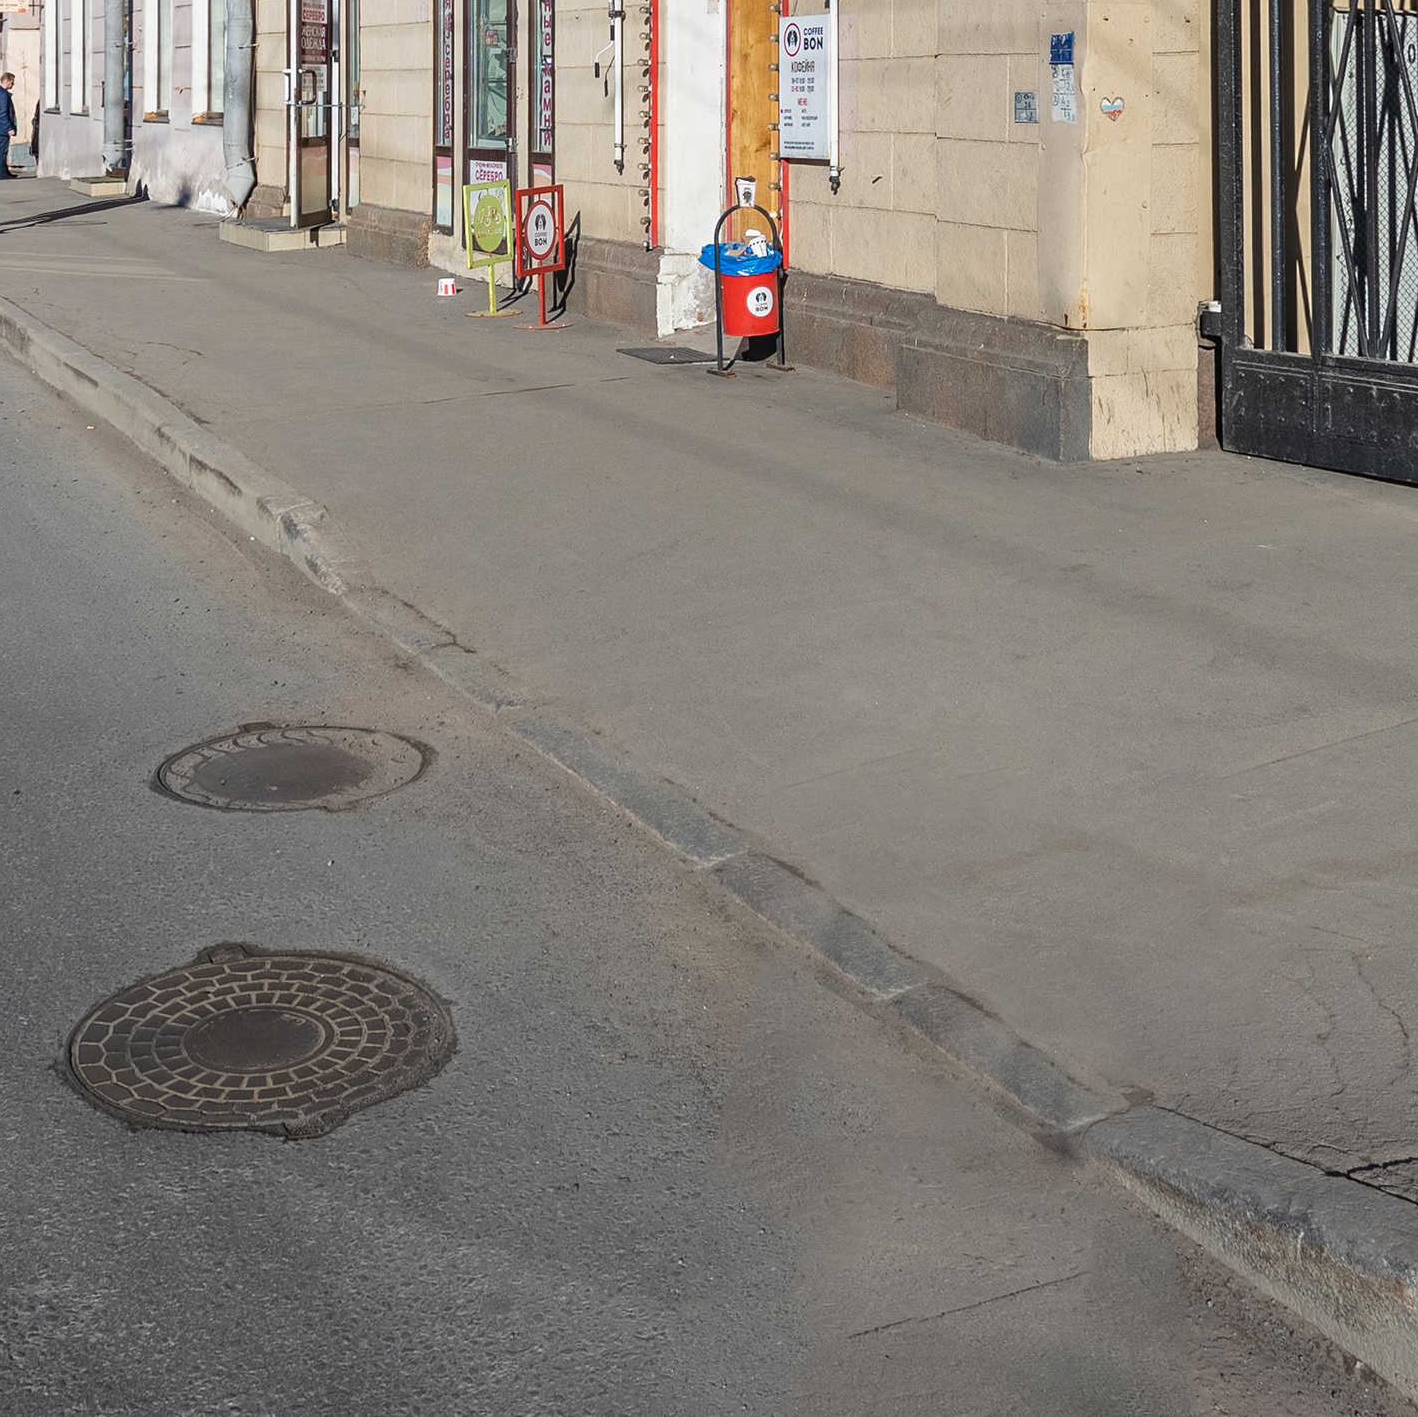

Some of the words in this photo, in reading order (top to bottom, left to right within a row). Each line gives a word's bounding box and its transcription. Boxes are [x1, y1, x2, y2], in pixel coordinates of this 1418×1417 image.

[303, 9, 325, 21] СЕРЕБРО
[803, 27, 824, 36] COFFEE
[301, 36, 326, 50] ОДЕЖДА
[803, 36, 824, 51] BON
[791, 59, 815, 73] КОФЕЙНЯ
[475, 169, 503, 183] СЕРЕБРО
[534, 238, 547, 246] BON
